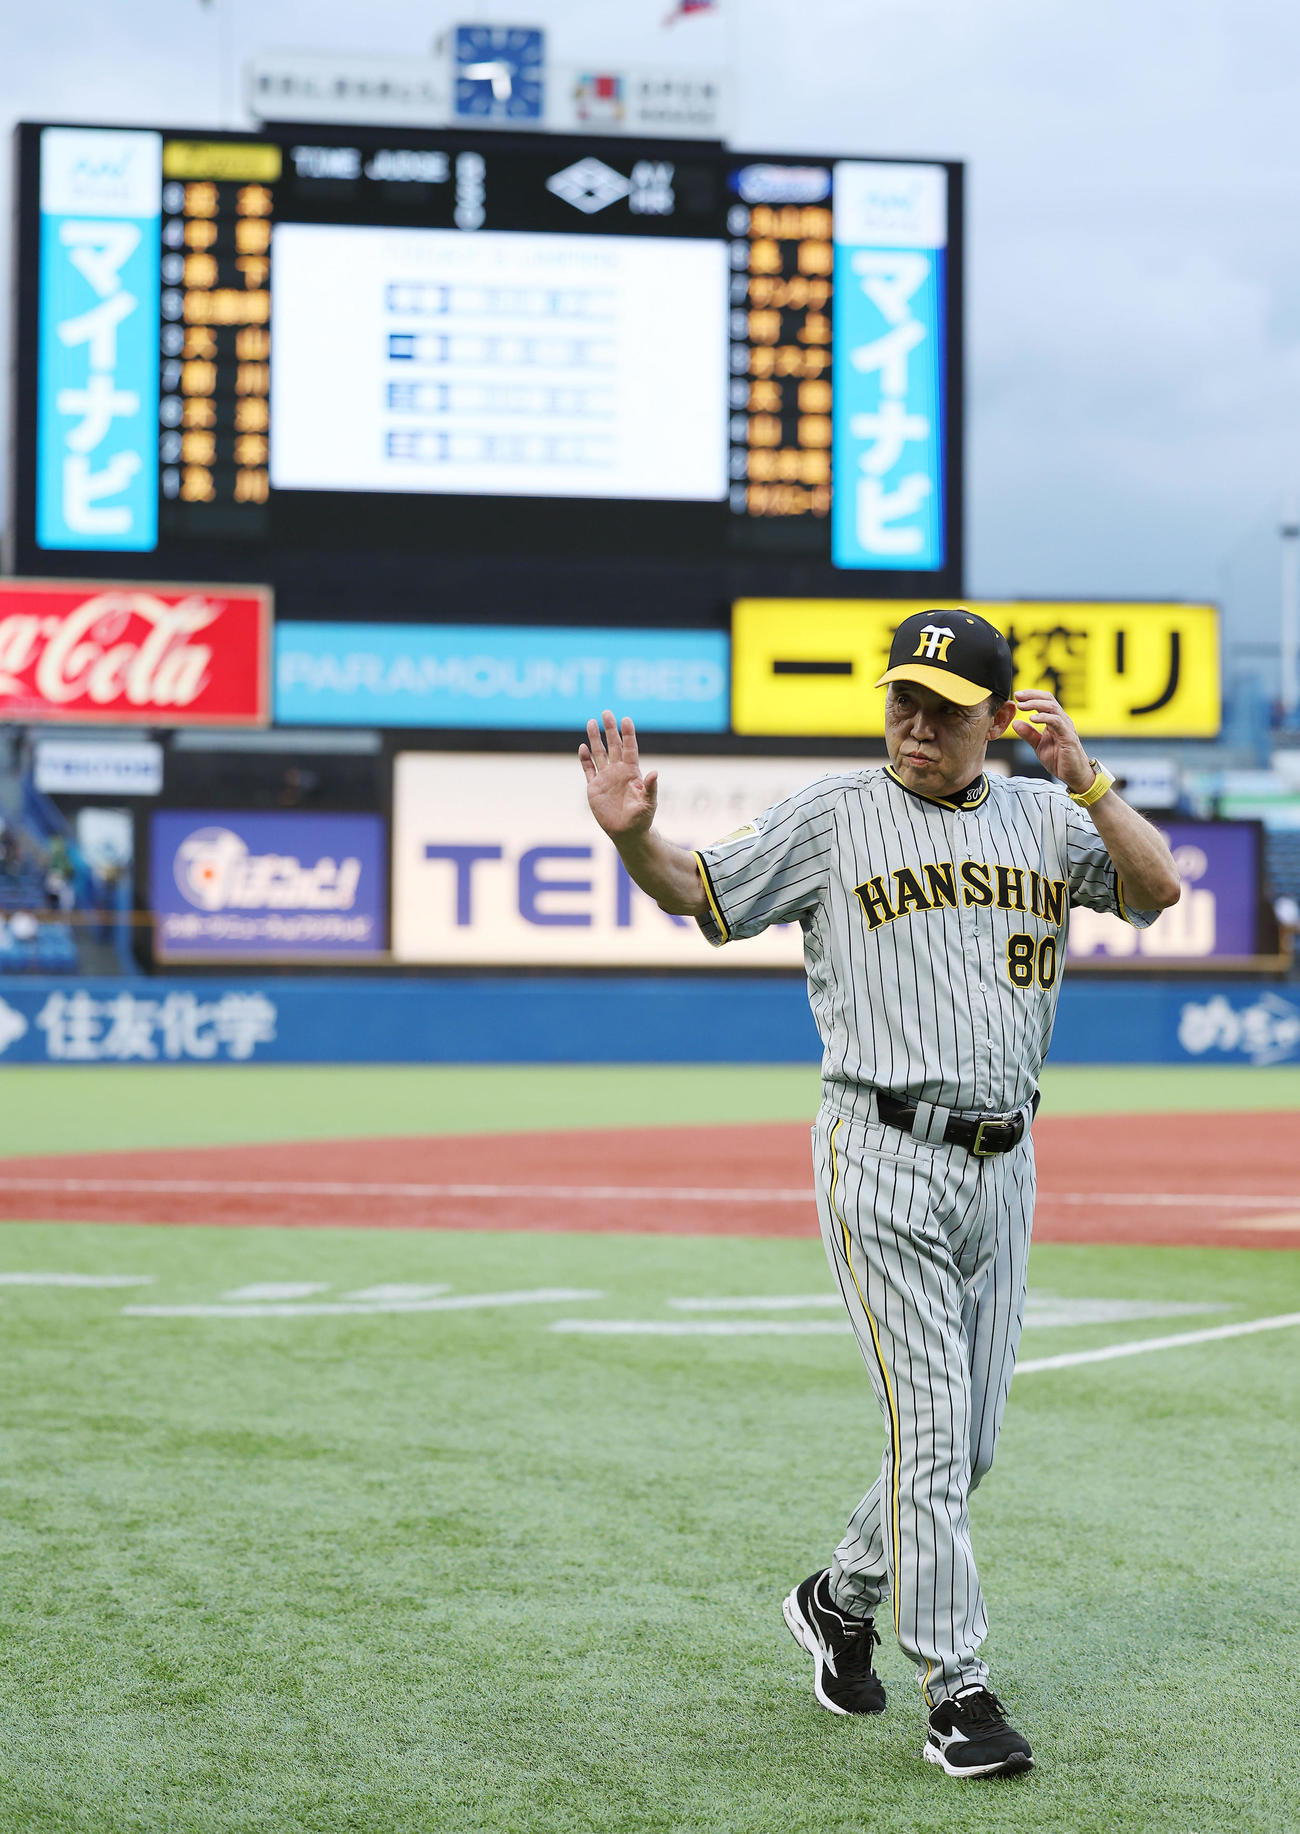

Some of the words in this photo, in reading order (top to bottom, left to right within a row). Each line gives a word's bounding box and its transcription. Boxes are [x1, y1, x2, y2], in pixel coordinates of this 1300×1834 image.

[59, 219, 142, 535] マイナビ
[850, 250, 931, 556] マイナビ
[276, 652, 609, 698] PARAMOUNT
[616, 659, 724, 701] BED
[853, 860, 1067, 931] HANSHIN
[1006, 933, 1057, 991] 80
[36, 990, 277, 1060] 住友化学
